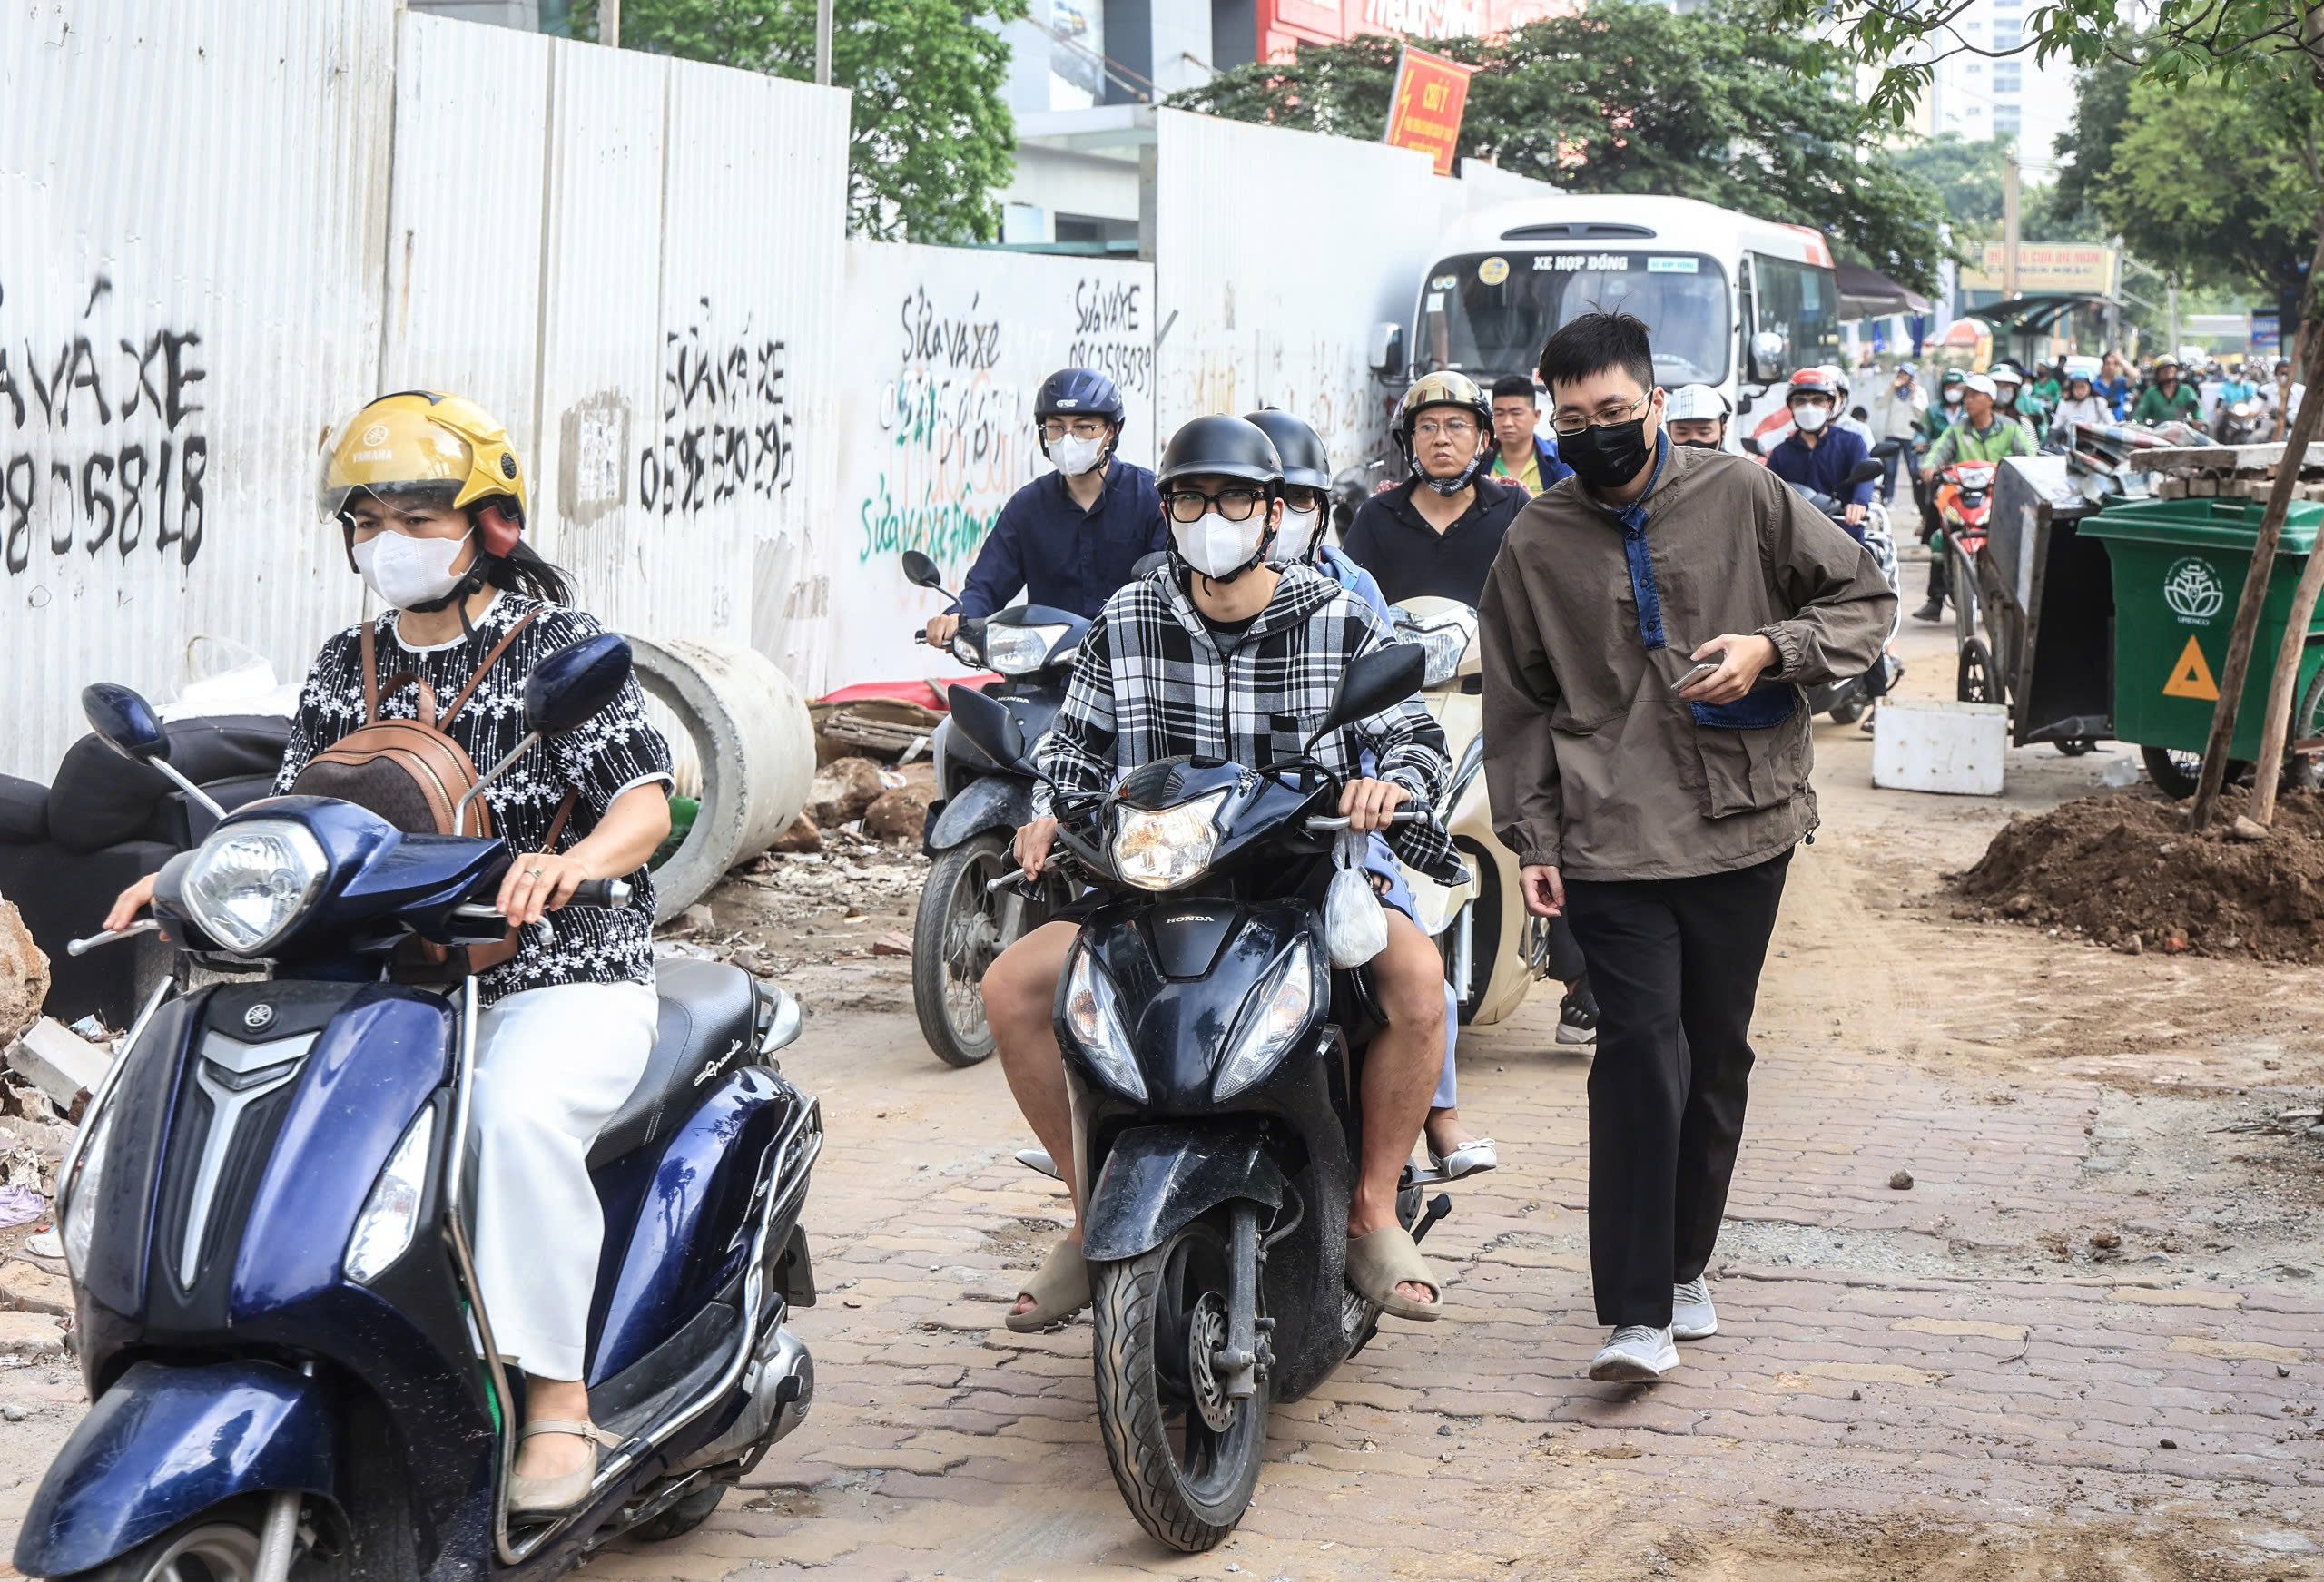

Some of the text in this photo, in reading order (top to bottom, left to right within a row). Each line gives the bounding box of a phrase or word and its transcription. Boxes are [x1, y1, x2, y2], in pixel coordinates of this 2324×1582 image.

[1533, 256, 1553, 270] XE
[1554, 256, 1585, 271] HỢP
[997, 696, 1030, 704] HONDA
[1166, 915, 1216, 924] HONDA
[702, 1039, 743, 1081] Grande
